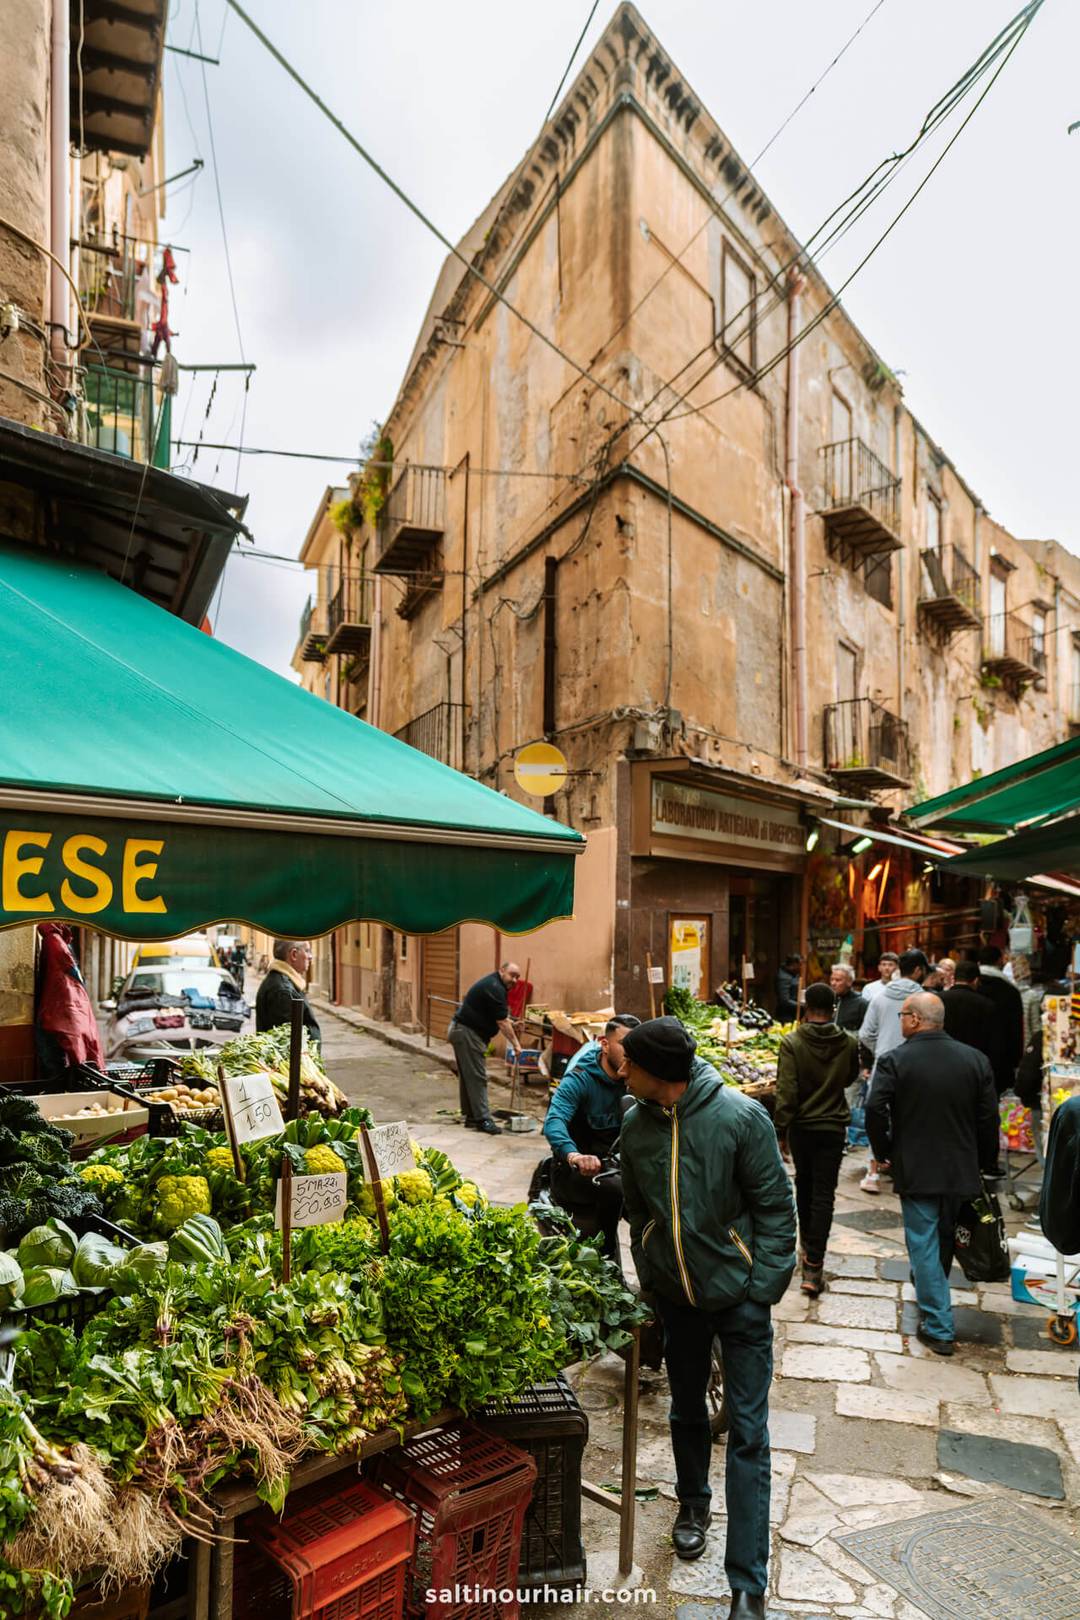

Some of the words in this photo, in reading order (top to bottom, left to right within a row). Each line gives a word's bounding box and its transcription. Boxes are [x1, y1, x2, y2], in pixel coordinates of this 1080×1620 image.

[656, 799, 716, 832] LABORATORIO
[2, 830, 168, 914] ESE
[239, 1081, 251, 1103] 1
